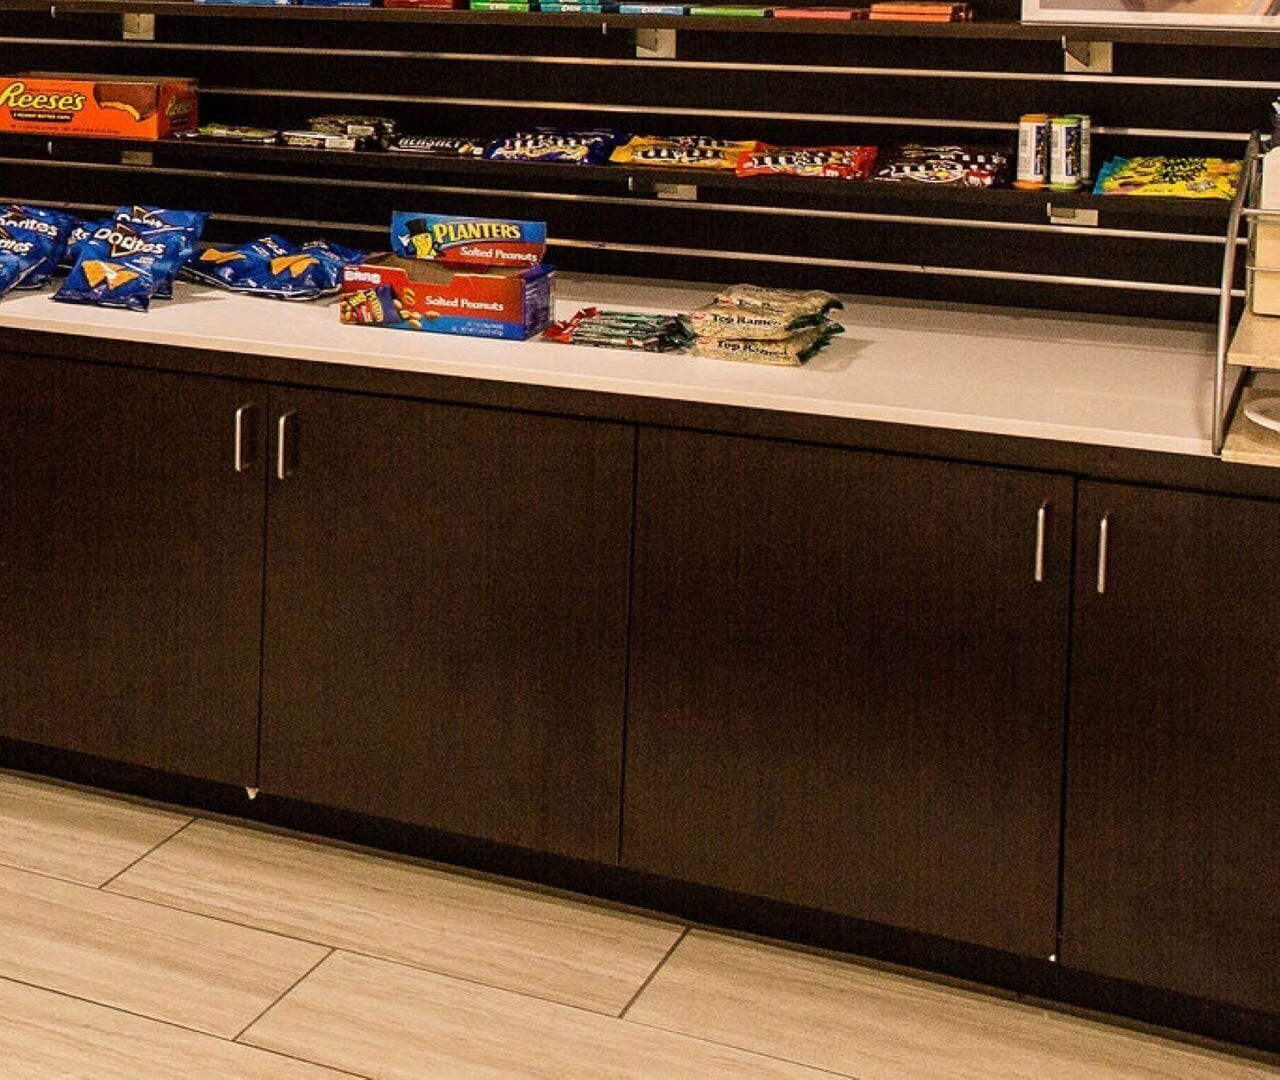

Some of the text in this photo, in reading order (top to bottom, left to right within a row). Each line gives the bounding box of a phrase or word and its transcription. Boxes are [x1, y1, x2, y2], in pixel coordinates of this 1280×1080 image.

[93, 226, 167, 255] Doritos
[432, 222, 522, 243] PLANTERS
[459, 246, 538, 263] Salted Peanuts
[425, 295, 505, 312] Salted Peanuts
[712, 314, 733, 324] Top
[716, 340, 737, 351] Top
